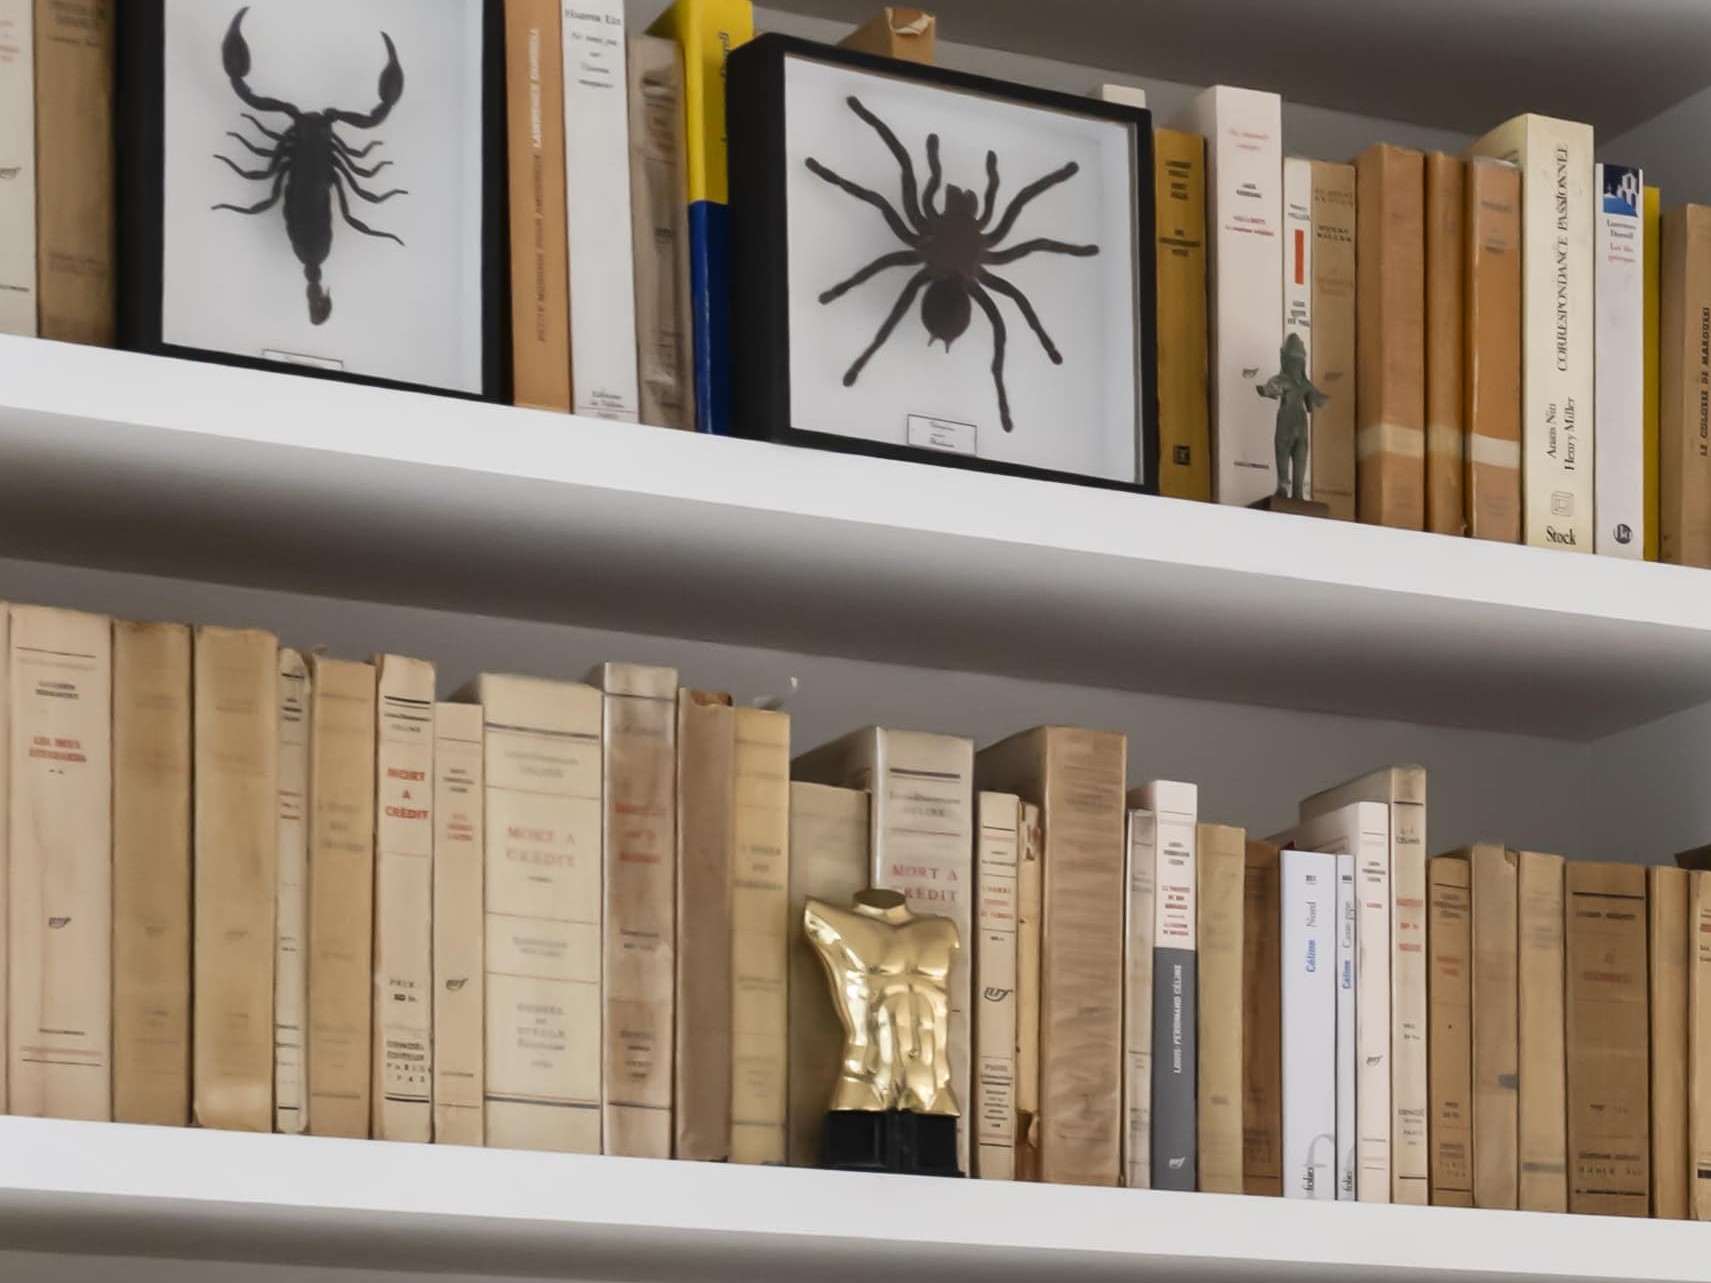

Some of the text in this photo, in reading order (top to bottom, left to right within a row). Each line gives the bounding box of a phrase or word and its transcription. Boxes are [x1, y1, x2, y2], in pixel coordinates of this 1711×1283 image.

[1563, 396, 1576, 471] Henry Miller
[1546, 529, 1577, 547] Stock
